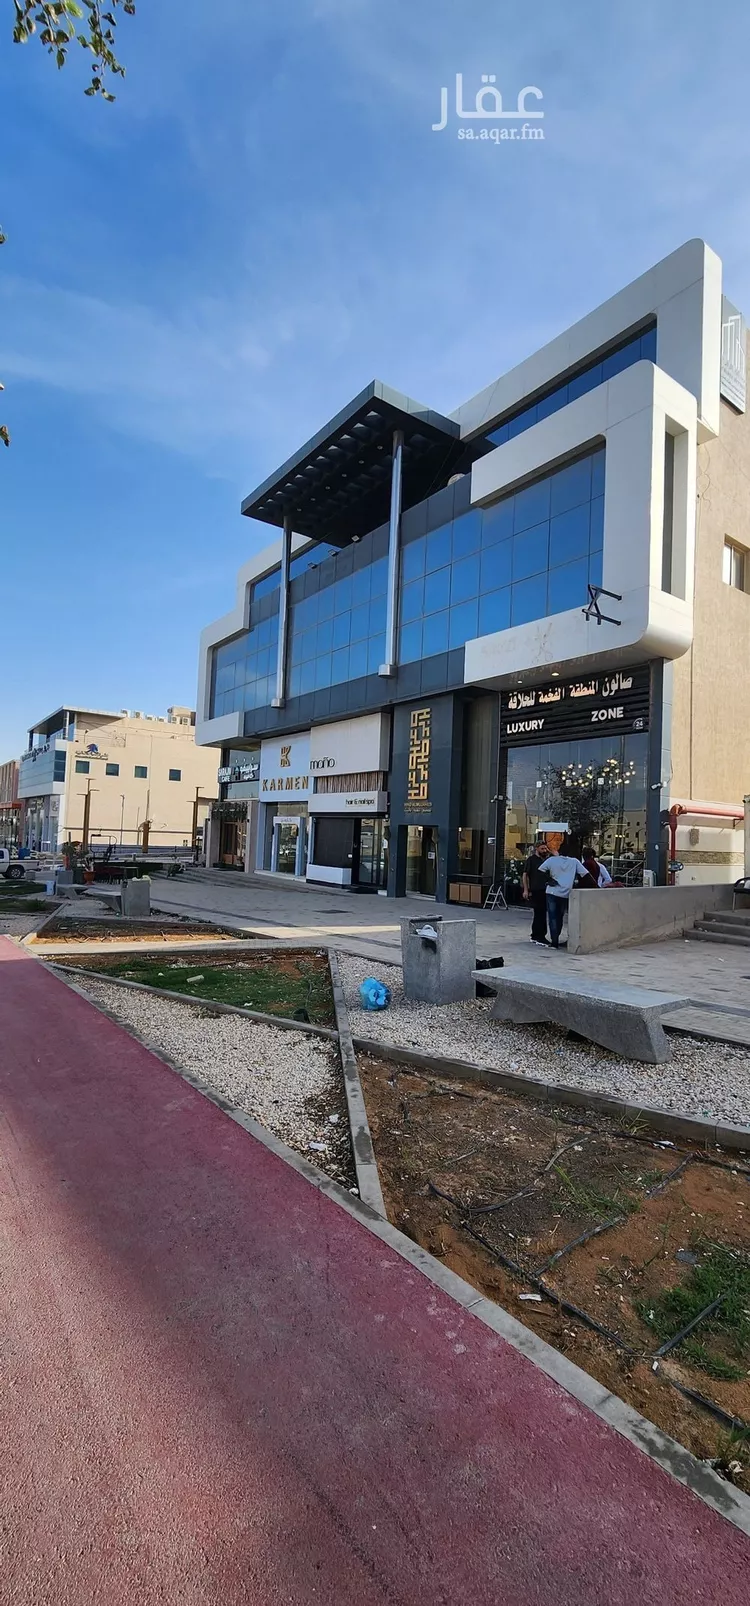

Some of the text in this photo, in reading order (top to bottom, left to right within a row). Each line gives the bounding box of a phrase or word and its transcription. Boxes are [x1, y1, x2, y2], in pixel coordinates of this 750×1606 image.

[569, 680, 599, 698] المنطقة
[601, 672, 633, 697] صالون
[508, 690, 536, 710] للحلاقة
[507, 706, 624, 734] LUXURY ZONE
[262, 775, 309, 791] KARMEN
